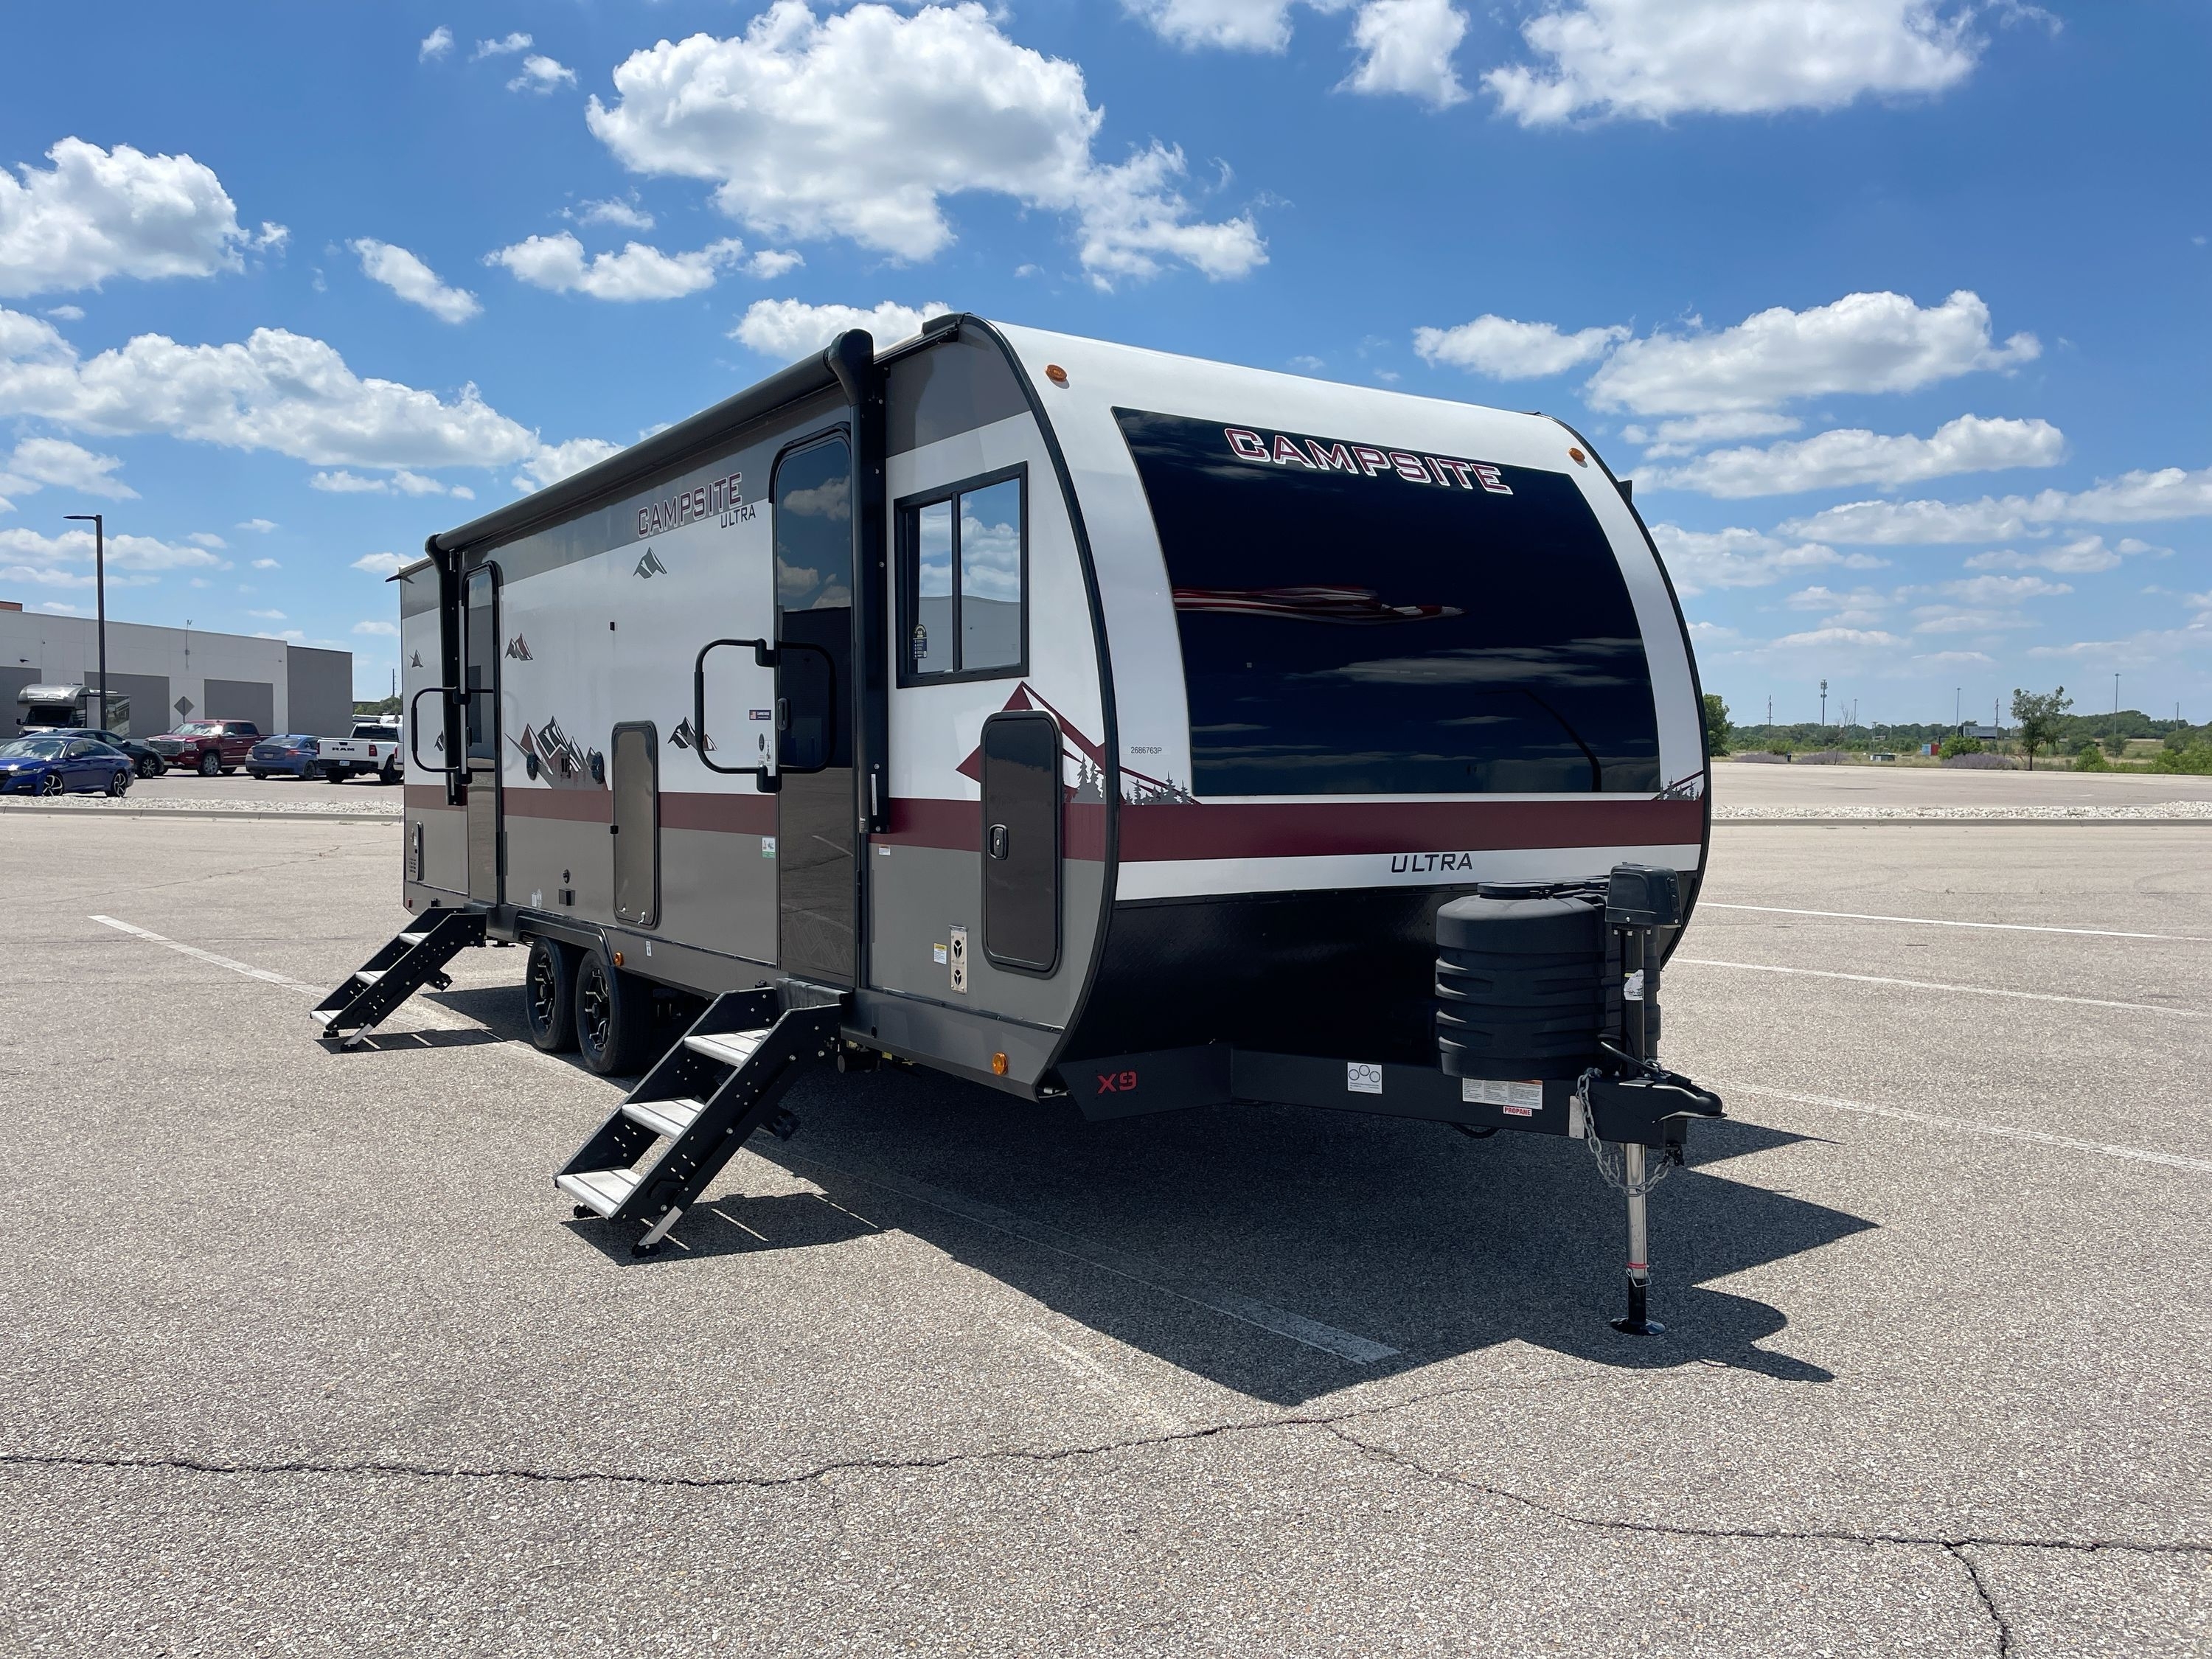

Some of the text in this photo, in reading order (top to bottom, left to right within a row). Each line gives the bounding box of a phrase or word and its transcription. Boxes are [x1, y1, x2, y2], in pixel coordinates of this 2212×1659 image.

[1223, 428, 1514, 495] CAMPSITE
[638, 472, 743, 538] CAMPSITE
[720, 504, 757, 529] ULTRA
[1130, 746, 1162, 754] 2686763P
[1391, 853, 1473, 873] ULTRA
[1097, 1071, 1138, 1094] X9
[1504, 1107, 1531, 1116] PROPANE
